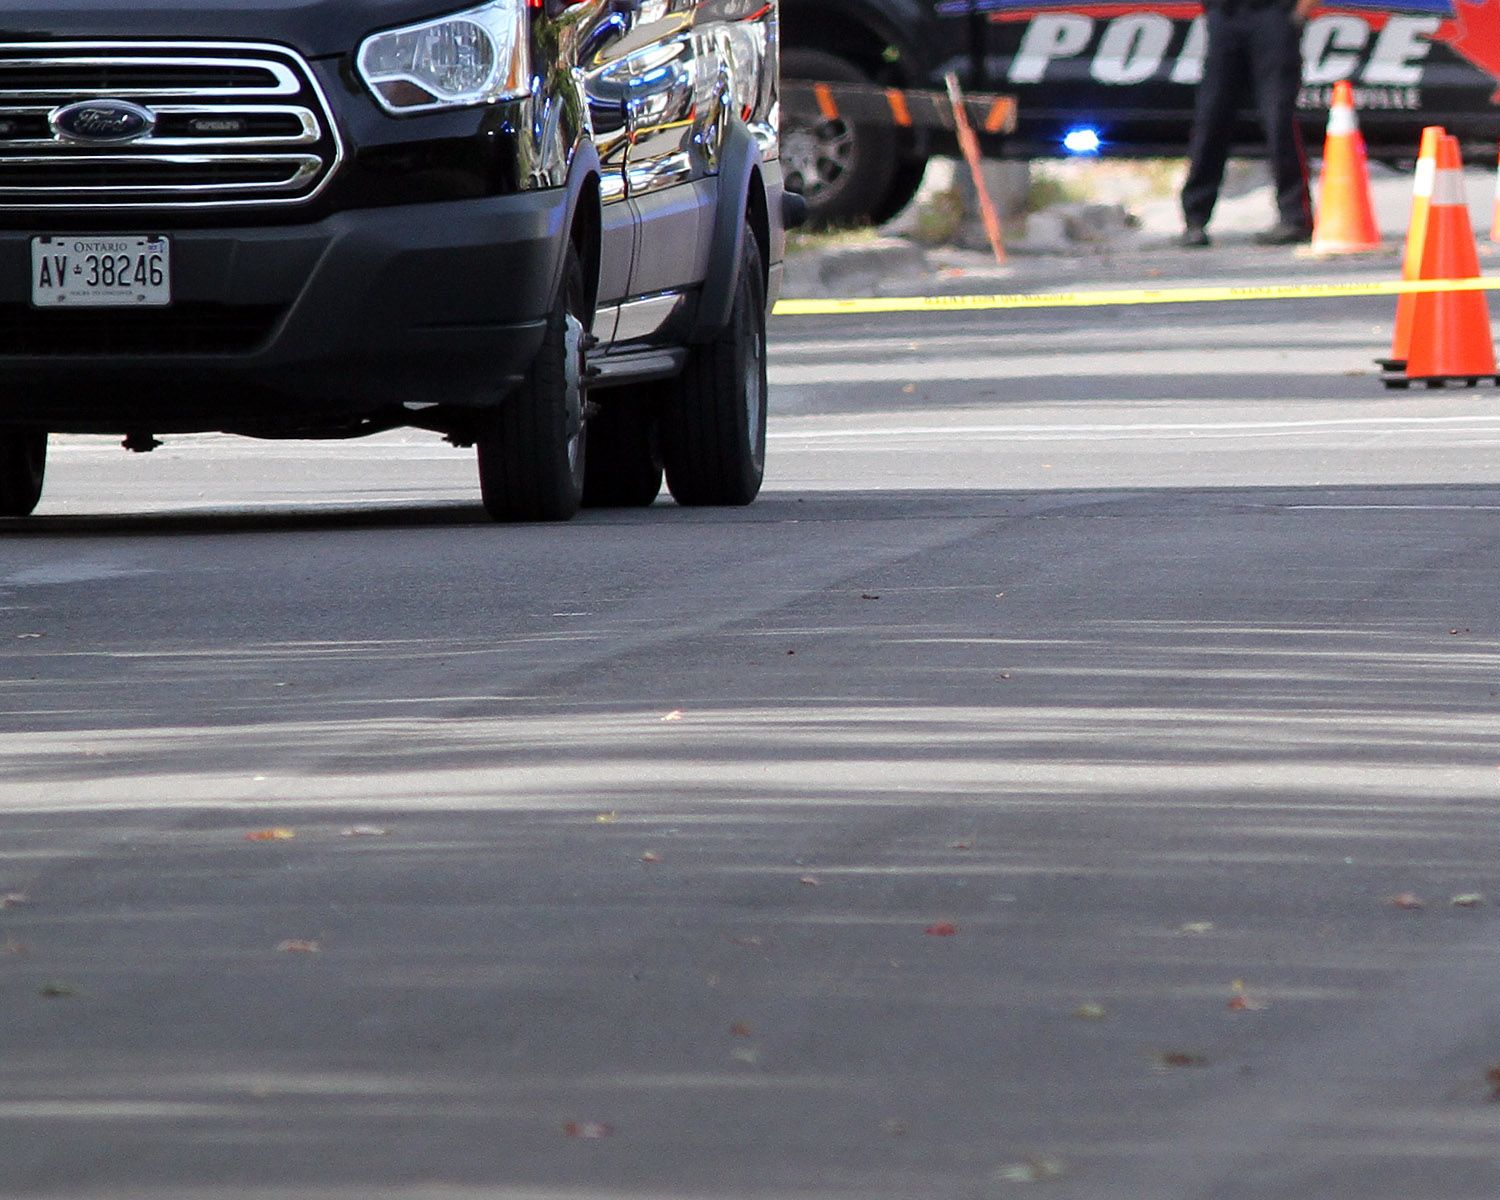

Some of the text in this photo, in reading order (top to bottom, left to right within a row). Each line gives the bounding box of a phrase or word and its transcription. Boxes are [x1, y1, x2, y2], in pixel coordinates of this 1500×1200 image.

[1008, 11, 1443, 86] POLCE
[73, 108, 128, 132] Ford
[74, 241, 128, 253] ONTARIO
